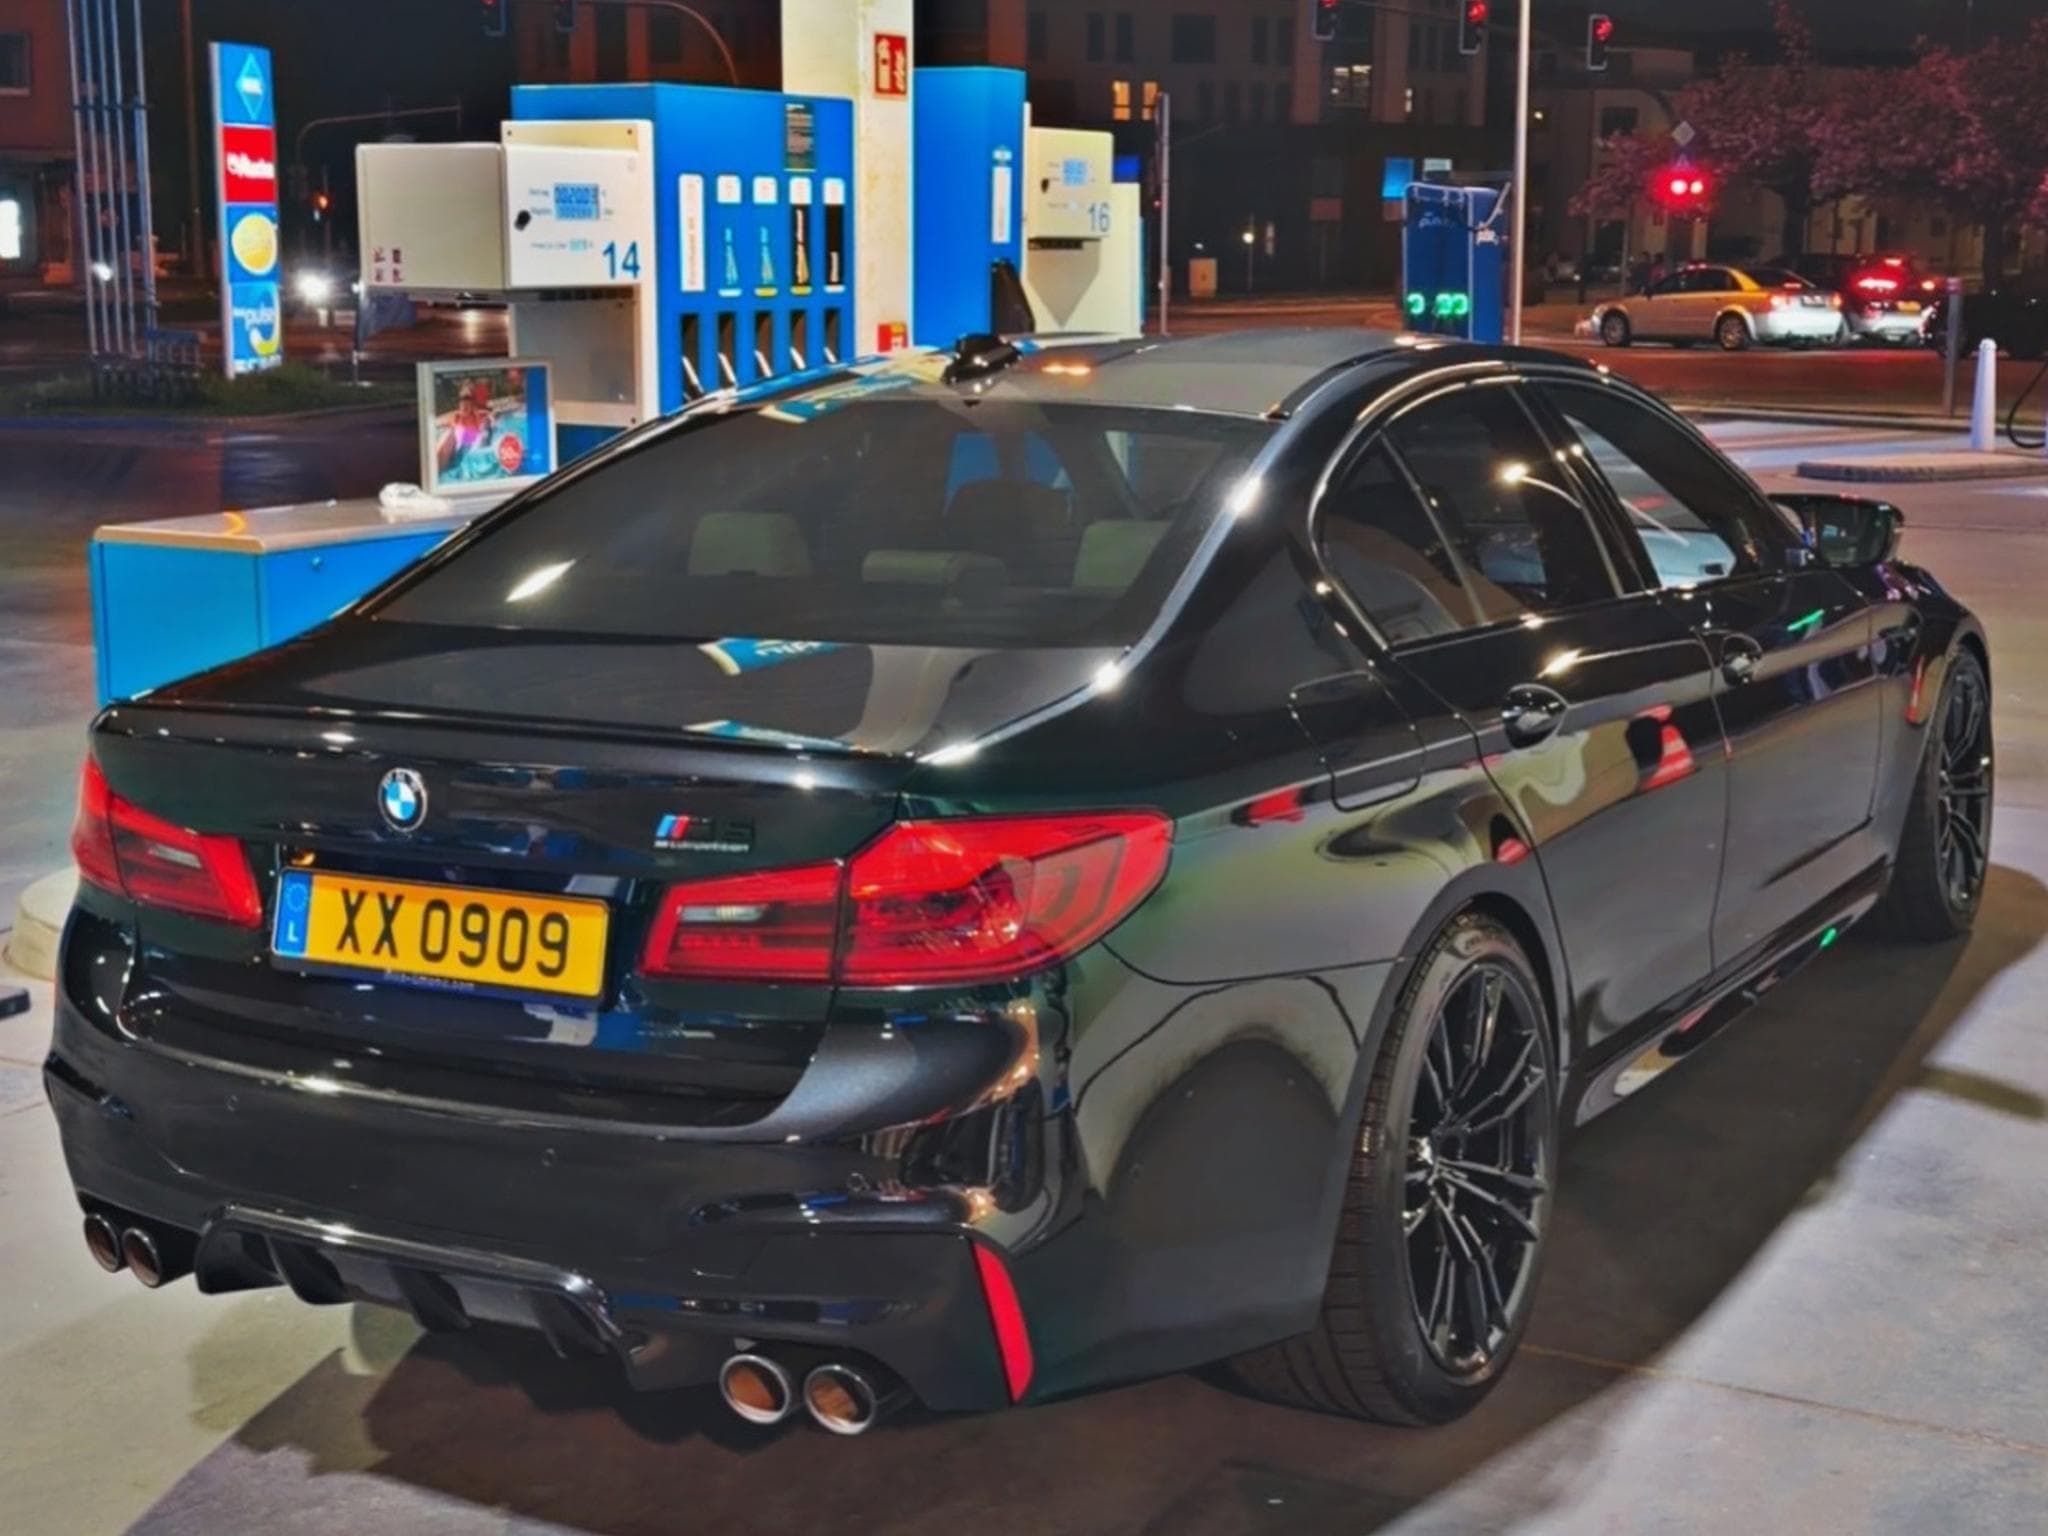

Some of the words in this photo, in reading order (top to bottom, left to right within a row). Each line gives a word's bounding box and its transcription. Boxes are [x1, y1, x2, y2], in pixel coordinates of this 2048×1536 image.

[1088, 202, 1110, 232] 16
[602, 241, 640, 279] 14
[286, 922, 299, 943] L
[336, 887, 405, 958] XX
[420, 898, 570, 979] 0909
